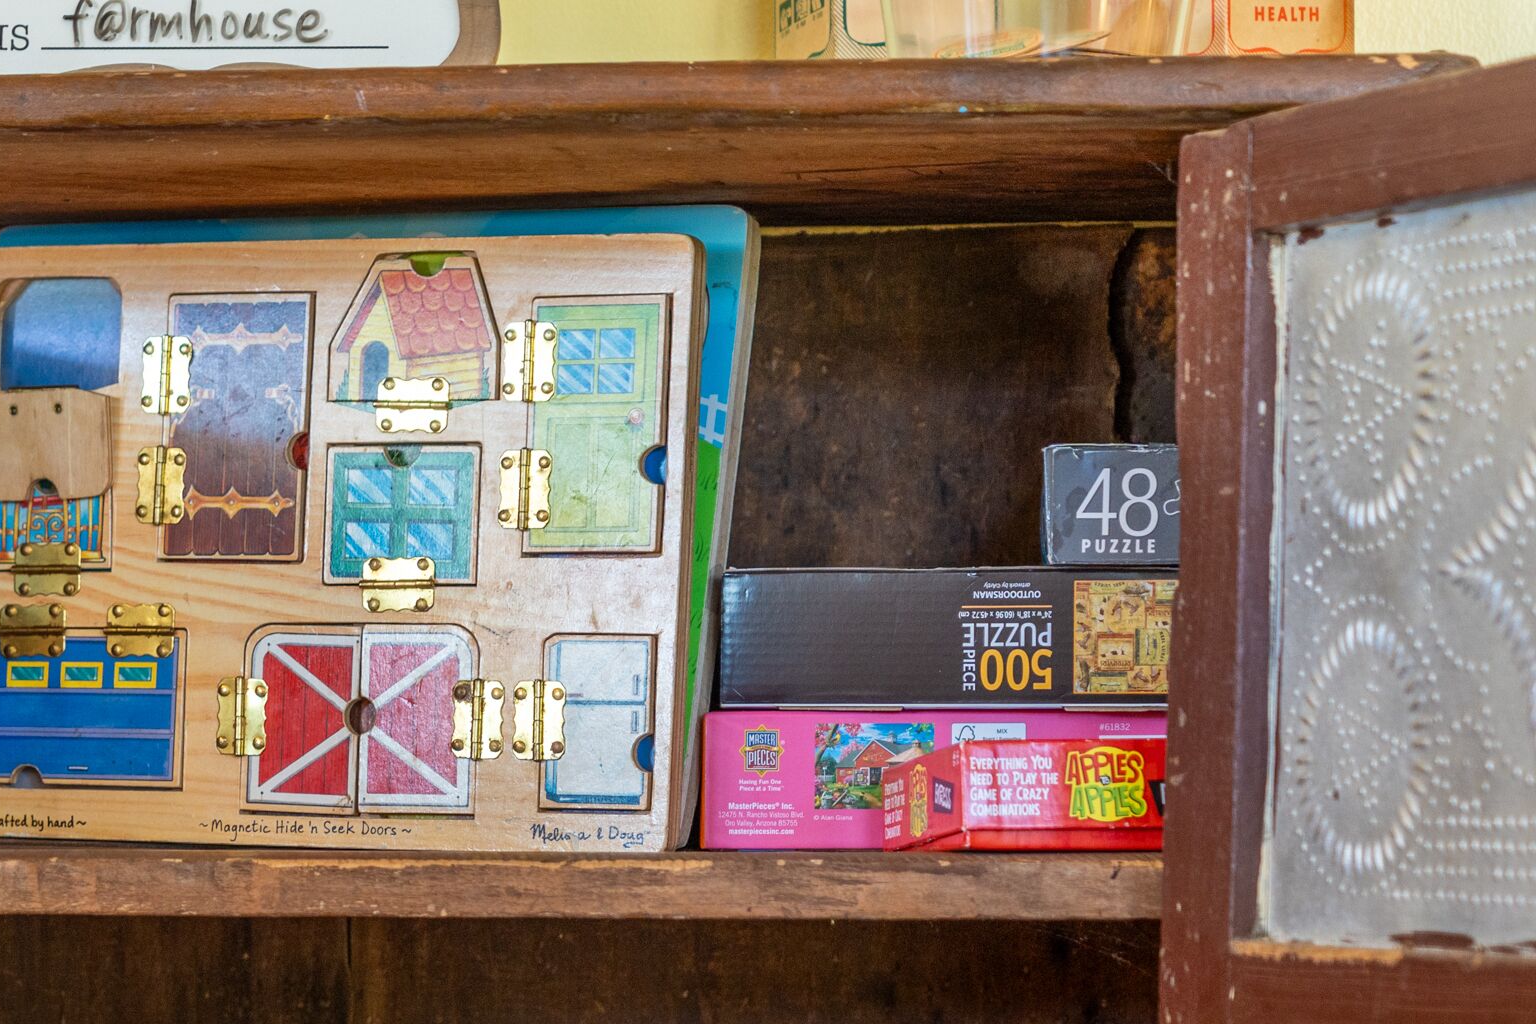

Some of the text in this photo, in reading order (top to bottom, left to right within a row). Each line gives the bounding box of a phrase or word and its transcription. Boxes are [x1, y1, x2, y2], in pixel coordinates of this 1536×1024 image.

[1254, 6, 1321, 23] HEALTH
[62, 0, 329, 47] farmhouse
[1075, 467, 1159, 537] 48
[1081, 538, 1157, 554] PUZZLE
[973, 590, 1042, 599] OUTDOORSMAN
[961, 622, 1052, 647] PUZZLE
[963, 650, 976, 691] PIECE
[979, 648, 1053, 691] 500
[1099, 723, 1130, 731] #61832
[748, 733, 776, 746] MASTER
[748, 751, 776, 766] PIECES
[970, 754, 1053, 770] EVERYTHING YOU
[1067, 751, 1141, 784] APPLES
[970, 771, 1059, 786] NEED TO PLAY THE
[970, 786, 1050, 800] GAME OF CRAZY
[1073, 784, 1146, 818] APPLES
[970, 803, 1041, 817] COMBINATIONS
[212, 818, 271, 837] Magnetic
[275, 819, 304, 835] Hide
[322, 820, 356, 837] Seek
[360, 820, 397, 837] Doors
[728, 828, 795, 836] masterpiecesinc.com
